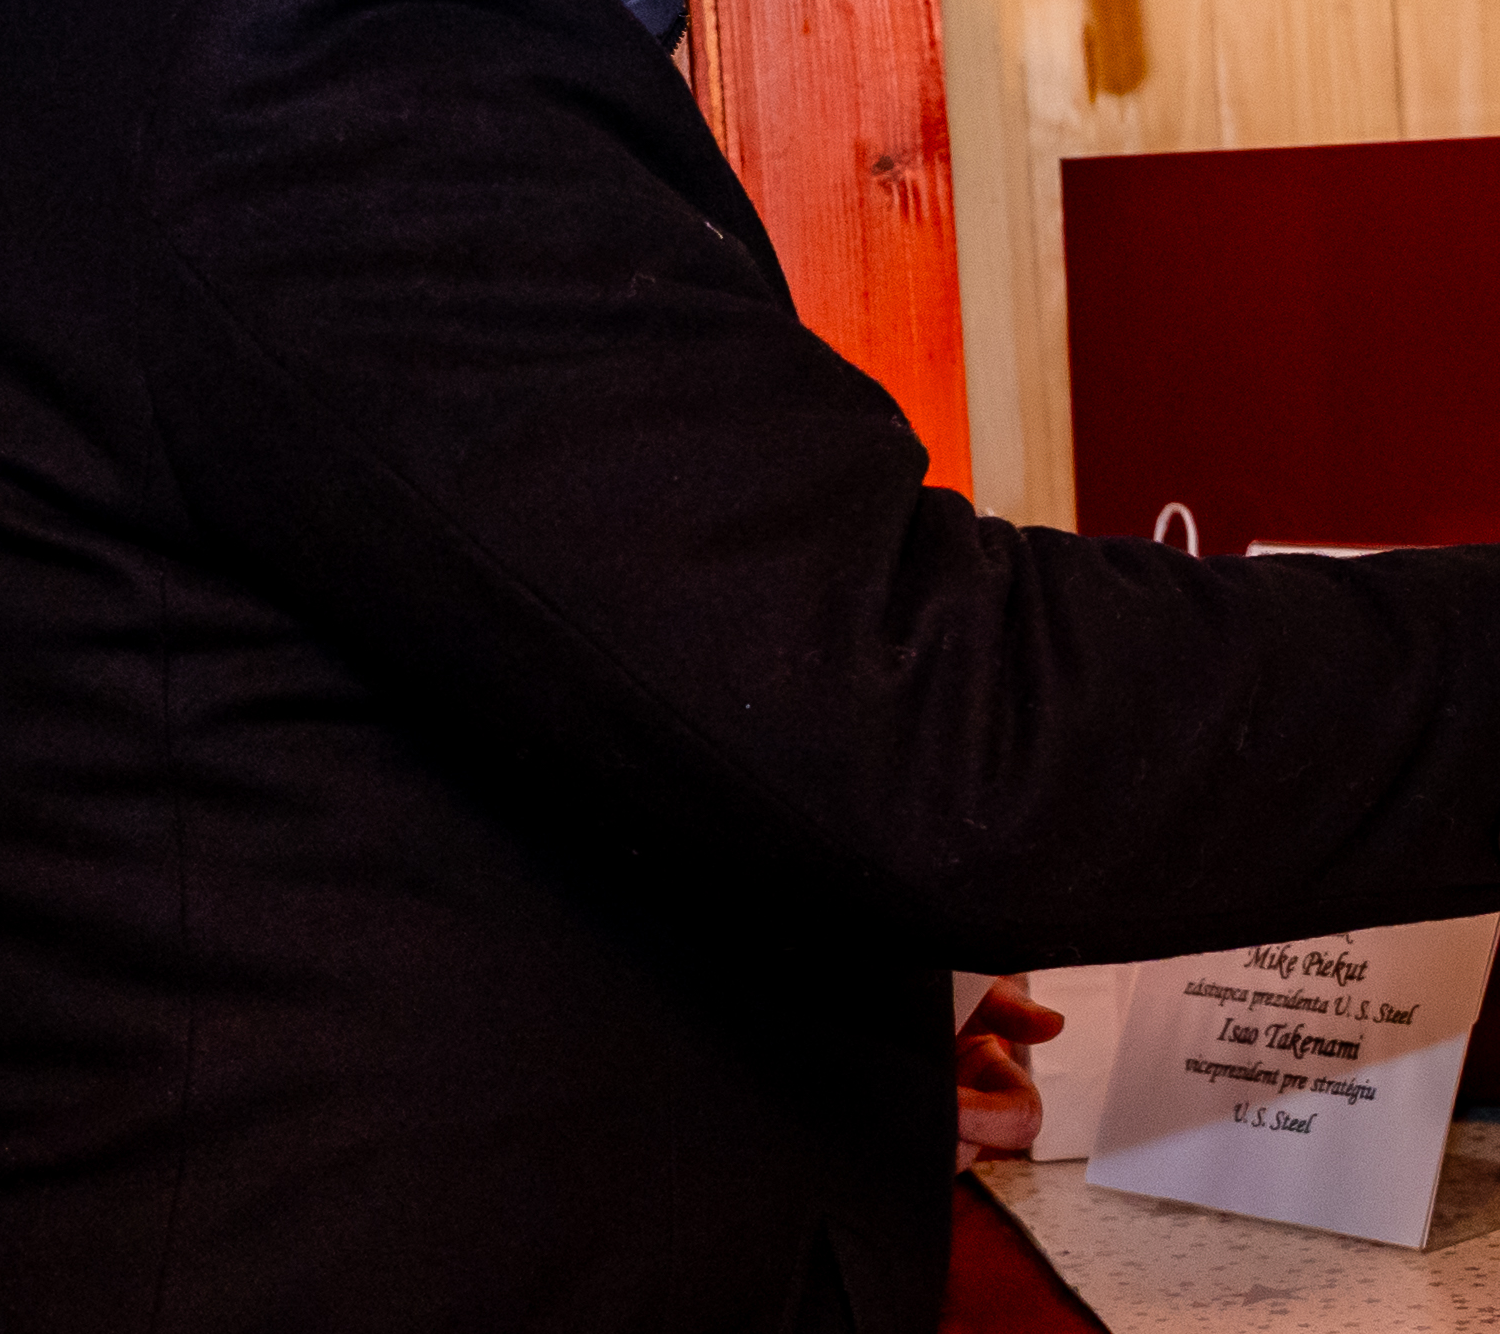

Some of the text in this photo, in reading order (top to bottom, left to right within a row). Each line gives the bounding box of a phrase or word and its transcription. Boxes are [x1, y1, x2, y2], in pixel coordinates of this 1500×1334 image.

[1243, 944, 1369, 987] Mike Piekut
[1248, 988, 1330, 1015] prezidenta
[1354, 1000, 1370, 1022] S.
[1372, 1002, 1421, 1026] Steel
[1216, 1017, 1364, 1061] Isao Takenami
[1184, 1057, 1378, 1106] viceprezident pre stratégiu
[1232, 1102, 1318, 1135] U. S. Steel
